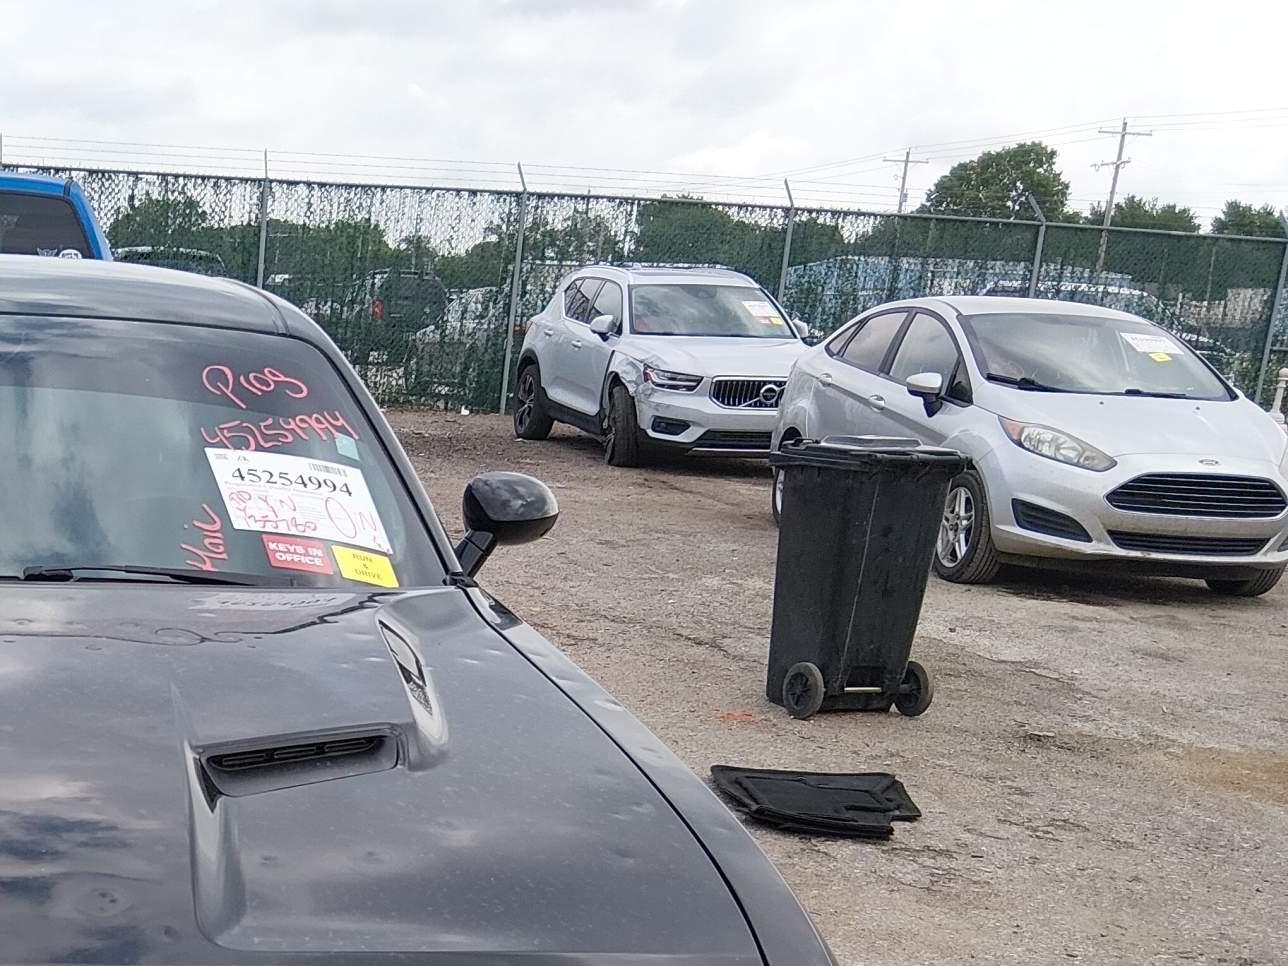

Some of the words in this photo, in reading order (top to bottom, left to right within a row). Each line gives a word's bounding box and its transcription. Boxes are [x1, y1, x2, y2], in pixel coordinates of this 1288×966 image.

[199, 410, 360, 452] 45254994
[231, 467, 353, 498] 45254994
[267, 542, 305, 555] KEYS
[308, 547, 324, 558] IN
[275, 554, 325, 567] OFFICE
[352, 553, 374, 563] RUN
[354, 568, 384, 580] DRIVE
